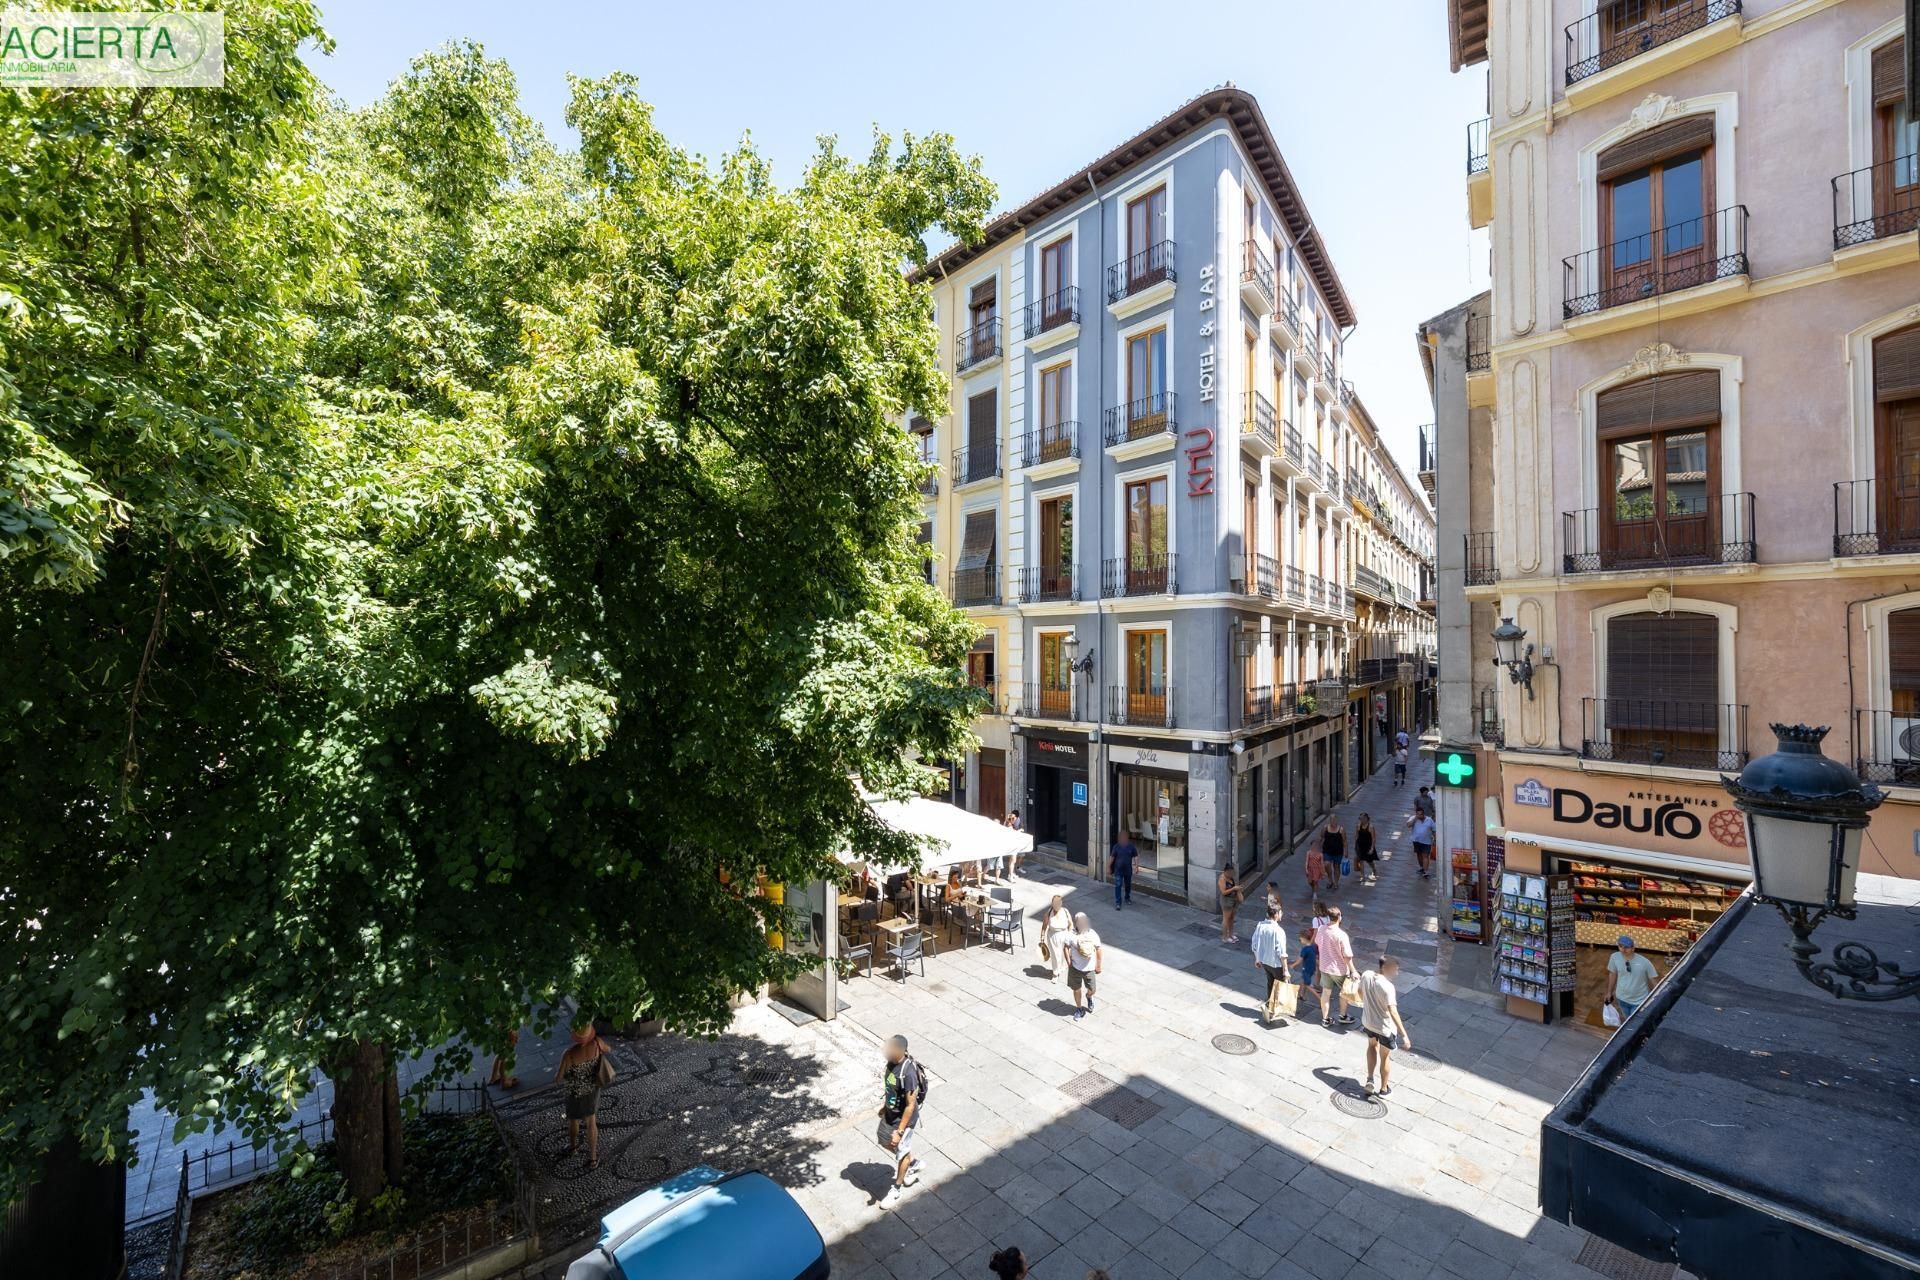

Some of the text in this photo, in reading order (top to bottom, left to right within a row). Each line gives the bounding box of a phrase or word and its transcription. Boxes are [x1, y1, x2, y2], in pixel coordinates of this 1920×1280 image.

[1199, 264, 1214, 312] BAR
[1199, 321, 1214, 337] &
[1199, 345, 1214, 402] HOTEL
[1054, 744, 1077, 754] HOTEL
[1553, 788, 1701, 840] Dauro
[1628, 791, 1719, 808] ARTESANIAS
